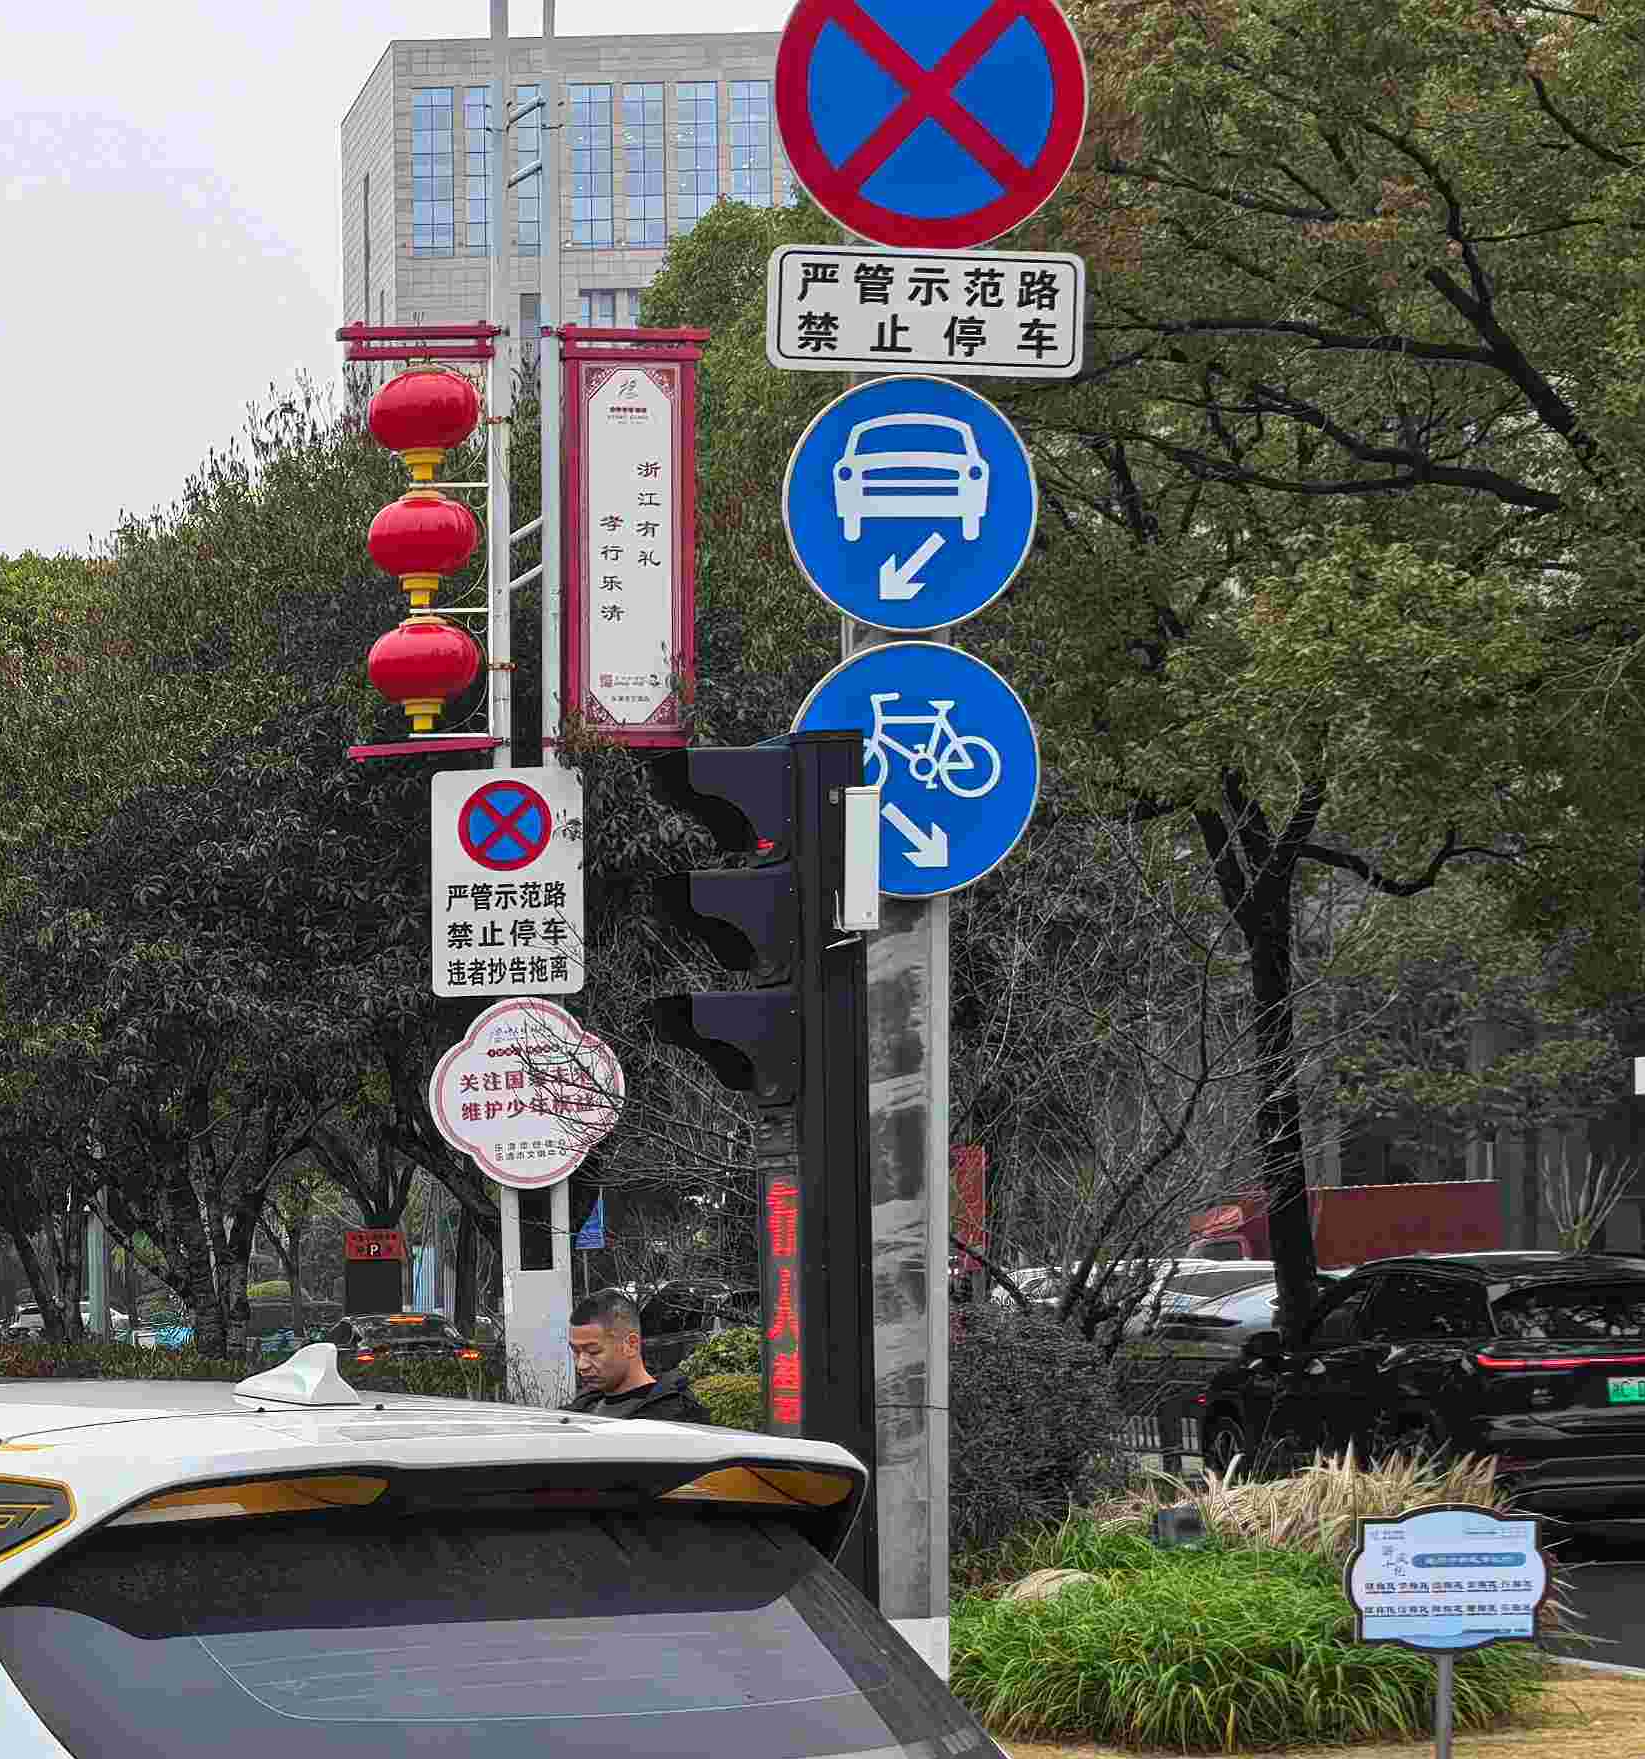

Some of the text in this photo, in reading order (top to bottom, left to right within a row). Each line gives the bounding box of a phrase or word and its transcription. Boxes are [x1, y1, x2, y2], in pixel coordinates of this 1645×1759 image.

[797, 262, 1060, 312] 严管示范路
[797, 311, 1059, 359] 禁止停车
[636, 460, 662, 568] 浙江有礼
[599, 515, 625, 623] 孝行乐清
[446, 881, 567, 912] 严管示范路
[447, 919, 568, 950] 禁止停车
[447, 955, 568, 988] 违者抄告拖离
